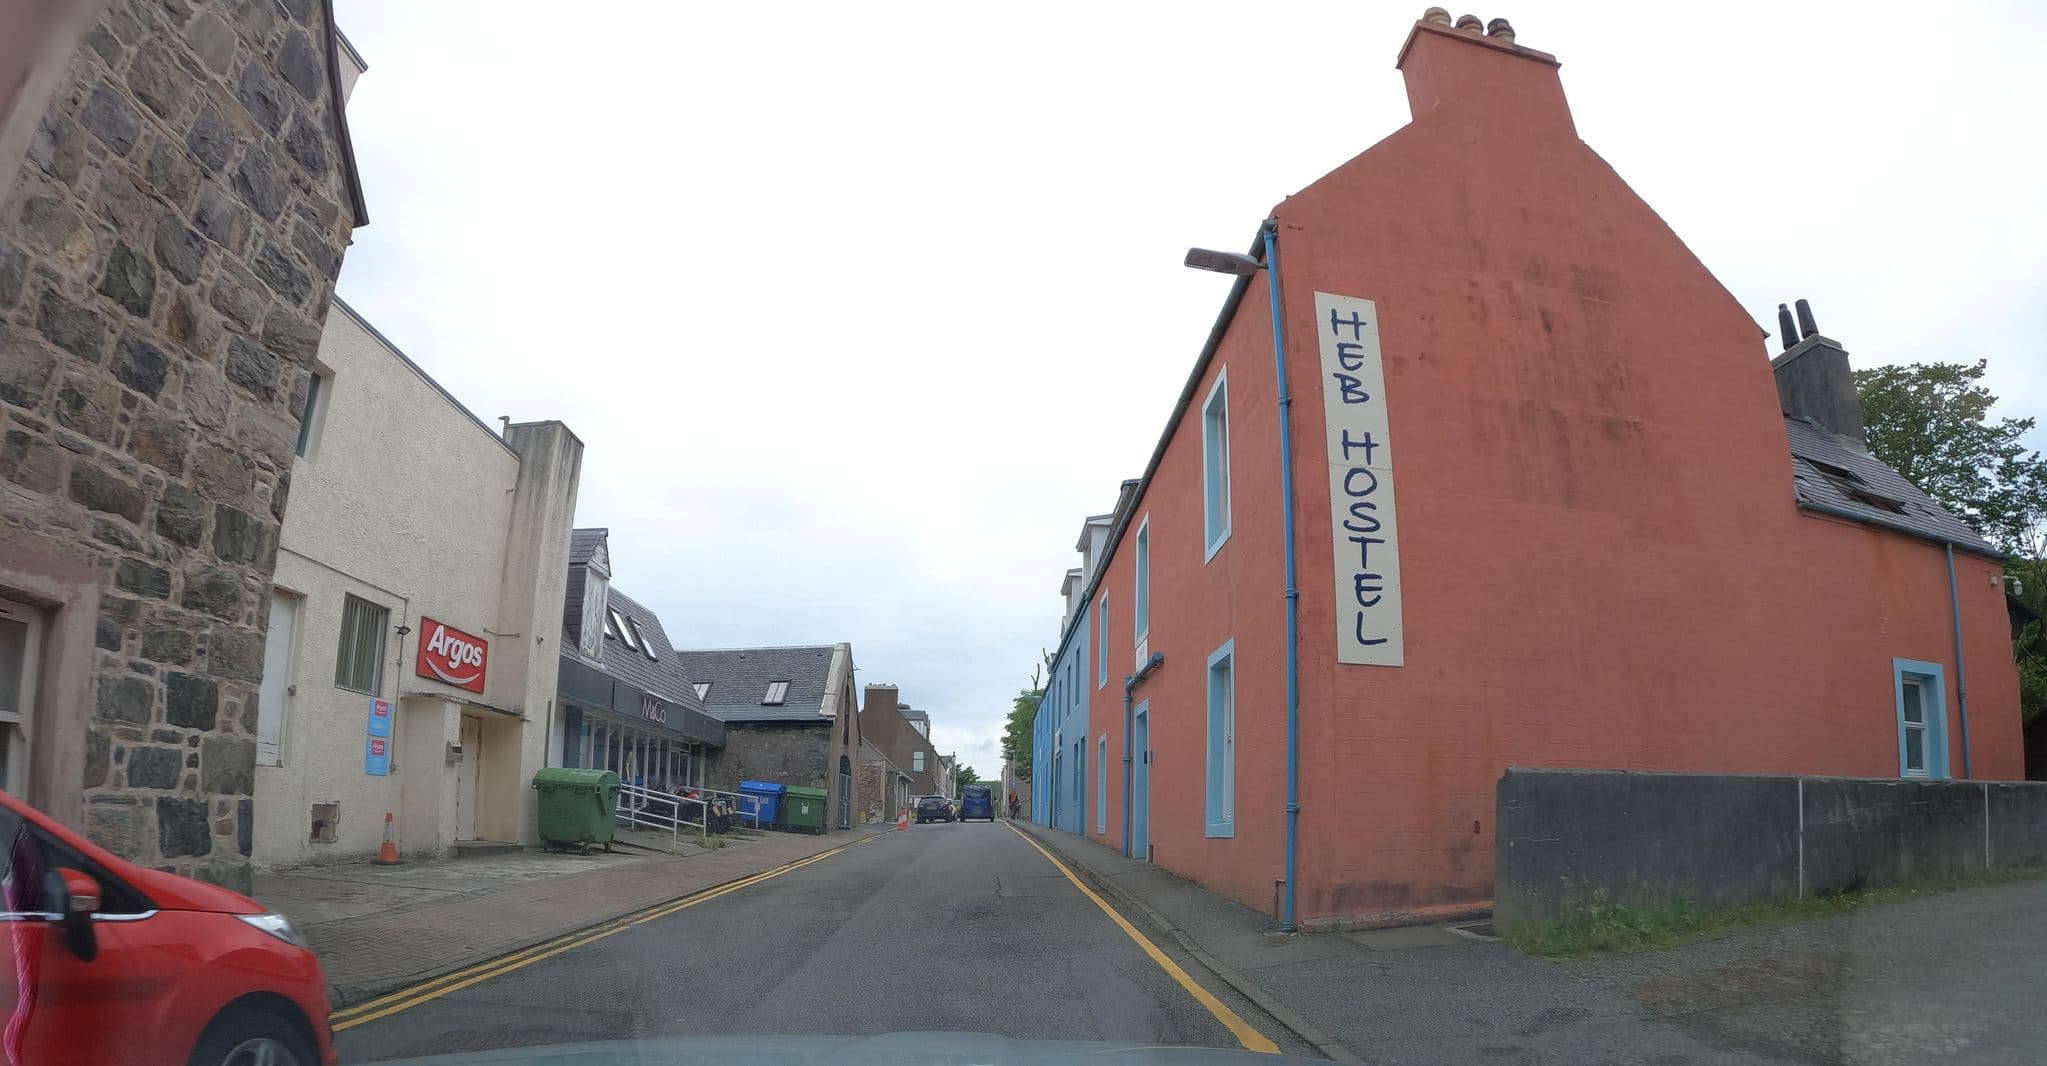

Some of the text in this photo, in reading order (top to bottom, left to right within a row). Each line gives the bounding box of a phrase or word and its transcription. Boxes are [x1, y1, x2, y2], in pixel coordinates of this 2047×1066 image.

[1330, 308, 1388, 646] HEB HOSTEL
[426, 624, 483, 669] Argos
[641, 696, 667, 724] M&Co
